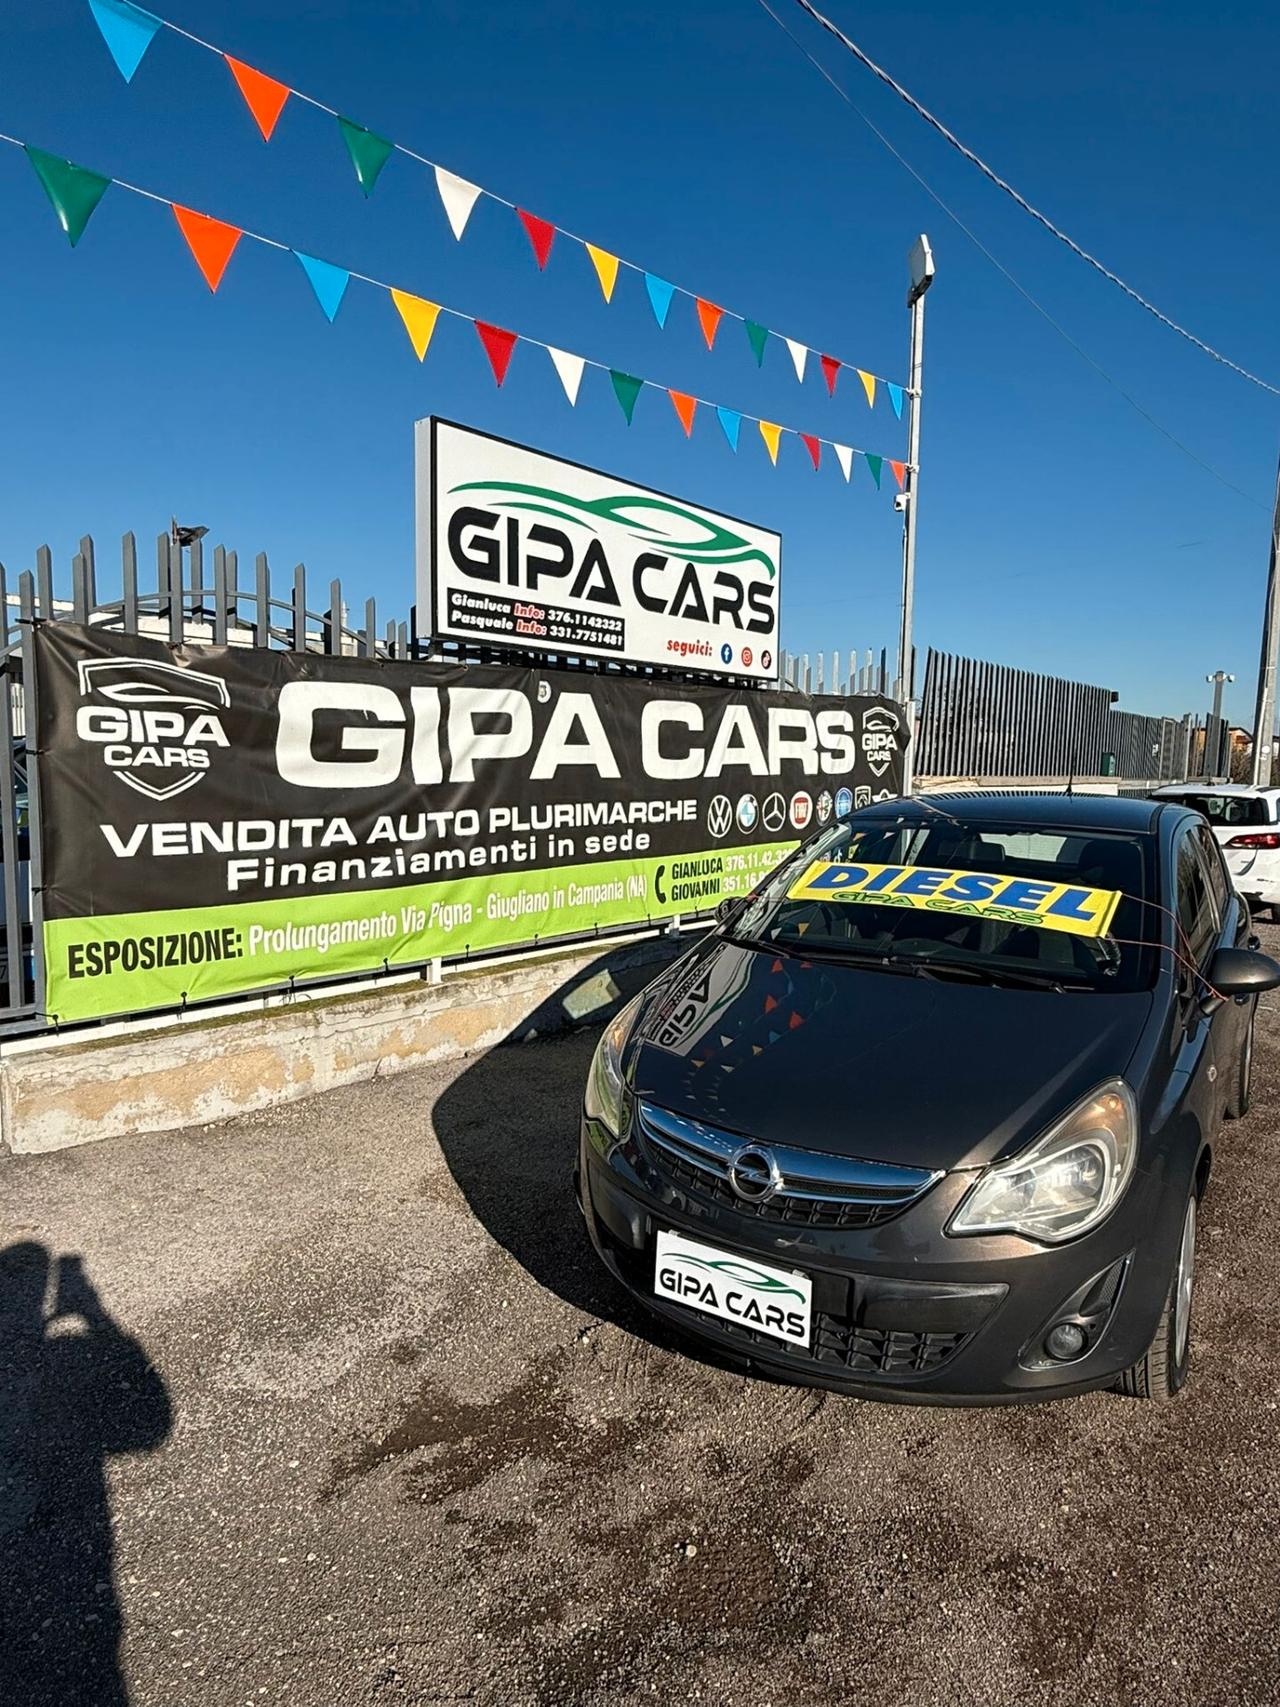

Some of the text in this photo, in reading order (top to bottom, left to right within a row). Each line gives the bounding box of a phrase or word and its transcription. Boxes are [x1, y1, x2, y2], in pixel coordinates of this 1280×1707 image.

[447, 506, 775, 635] GIPA CARS
[451, 593, 622, 632] Gianluca Info: 376.1142322
[451, 610, 623, 646] Pasquale Info: 331.7751481
[666, 639, 713, 657] seguici:
[76, 705, 230, 747] GIPA
[275, 681, 856, 788] GIPA CARS
[861, 733, 898, 750] GIPA
[104, 744, 210, 768] CARS
[866, 751, 892, 761] CARS
[100, 799, 697, 858] VENDITA AUTO PLURIMARCHE
[227, 829, 650, 892] Finanziamenti in sede
[672, 857, 723, 880] GIANLUCA
[671, 878, 720, 901] GIOVANNI
[805, 864, 1098, 922] DIESEL
[832, 891, 1047, 925] GIPA CARS
[68, 927, 243, 979] ESPOSIZIONE:
[248, 911, 396, 955] Prolungamento
[400, 906, 426, 934] Via
[428, 901, 472, 932] Pigna
[487, 889, 549, 921] Giugliano
[553, 886, 565, 909] in
[568, 877, 624, 908] Campania
[627, 874, 648, 902] (NA)
[659, 1268, 805, 1338] GIPA CARS
